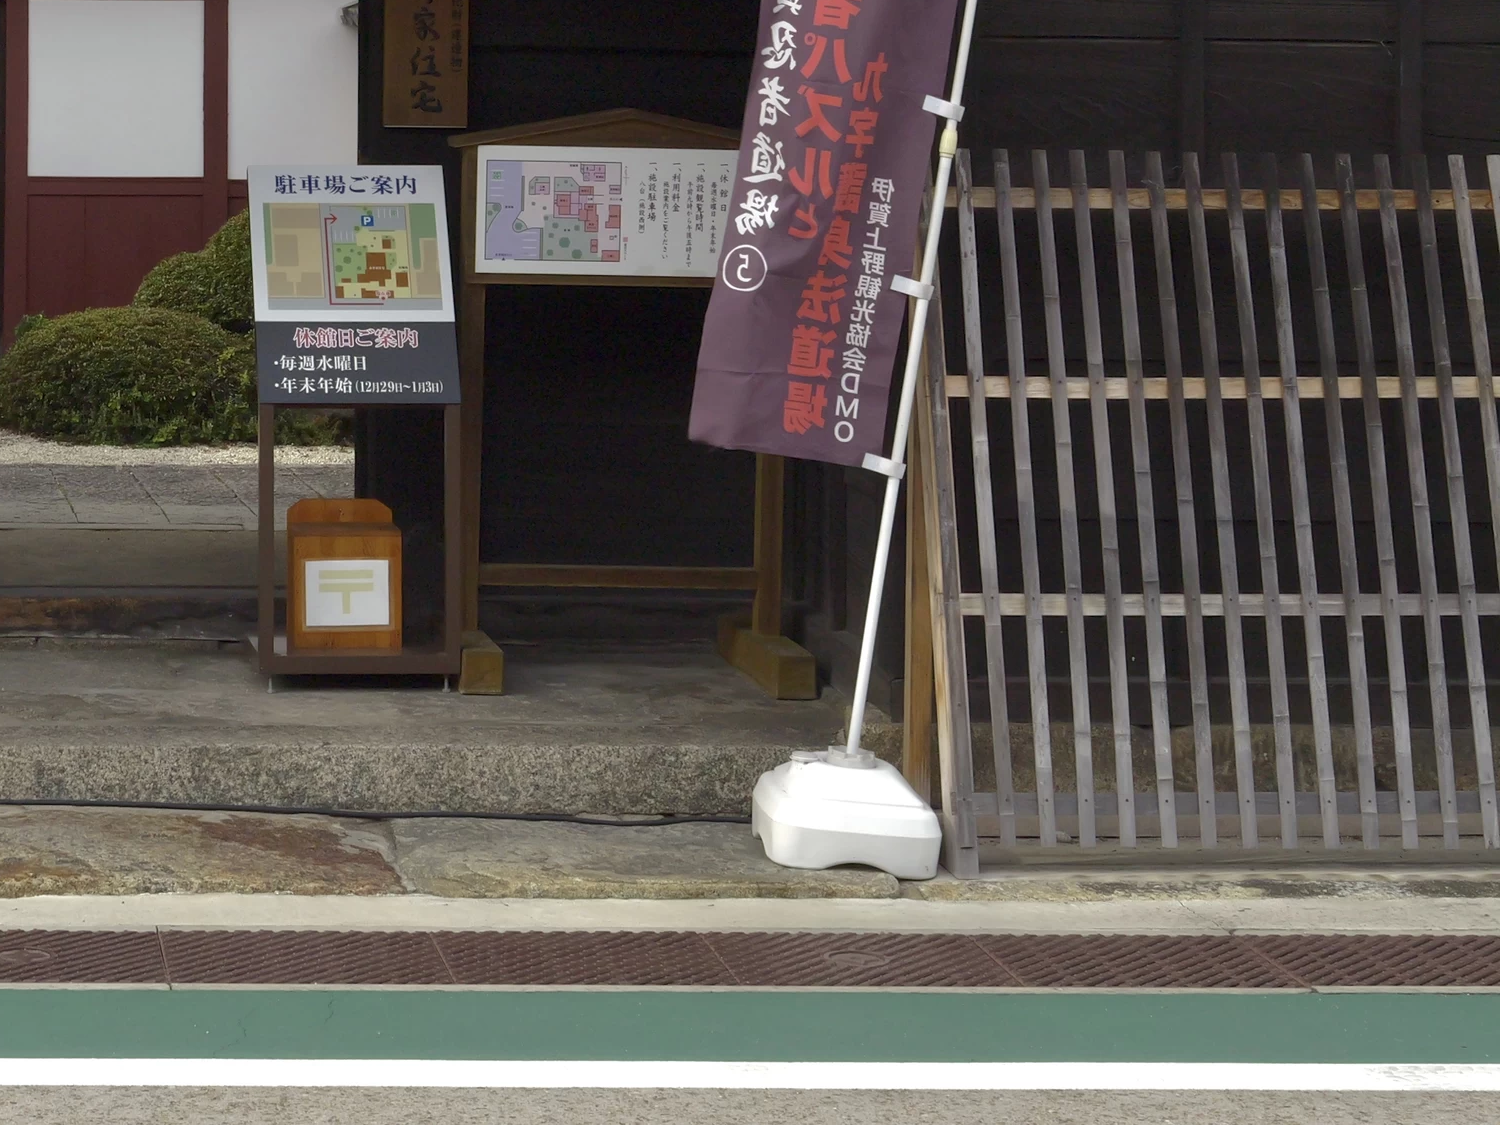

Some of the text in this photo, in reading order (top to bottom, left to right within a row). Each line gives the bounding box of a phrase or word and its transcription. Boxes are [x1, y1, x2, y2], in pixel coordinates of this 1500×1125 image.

[274, 174, 417, 195] 駐車場ご案内
[293, 327, 419, 348] 休館日ご案内
